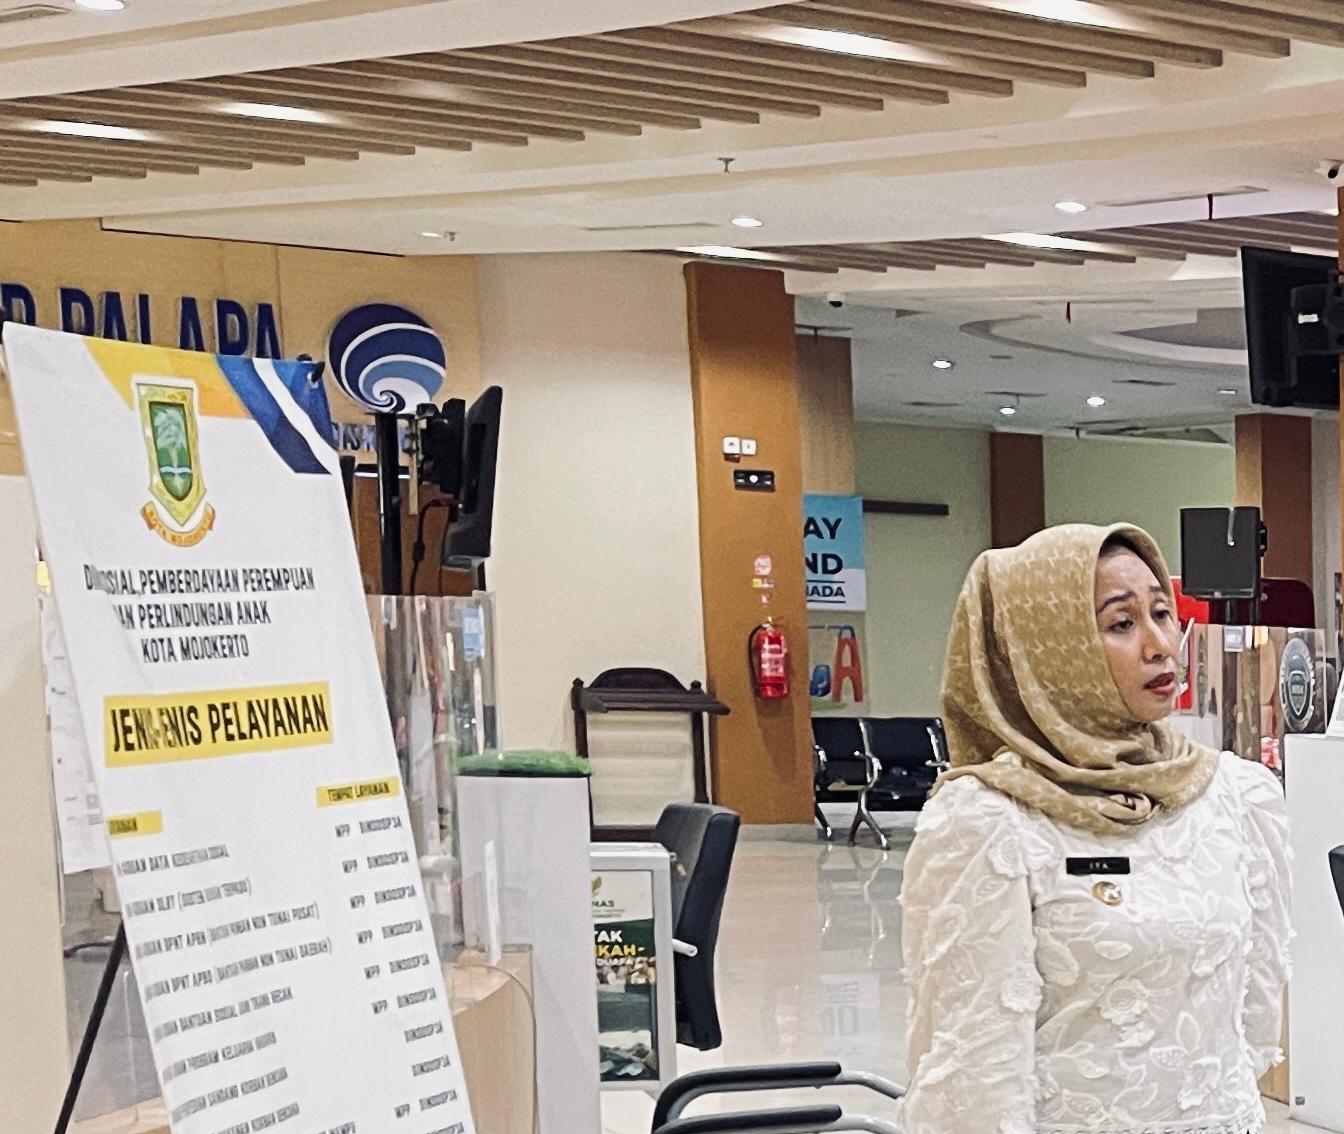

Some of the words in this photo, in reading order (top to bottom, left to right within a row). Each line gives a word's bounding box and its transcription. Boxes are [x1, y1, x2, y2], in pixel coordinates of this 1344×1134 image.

[242, 567, 315, 592] PEREMPUAN
[138, 602, 234, 629] PERLINDUNGAN
[237, 600, 272, 624] ANAK
[141, 637, 177, 663] KOTA
[179, 634, 249, 662] MOJOKERTO
[207, 694, 329, 744] PELAYANAN
